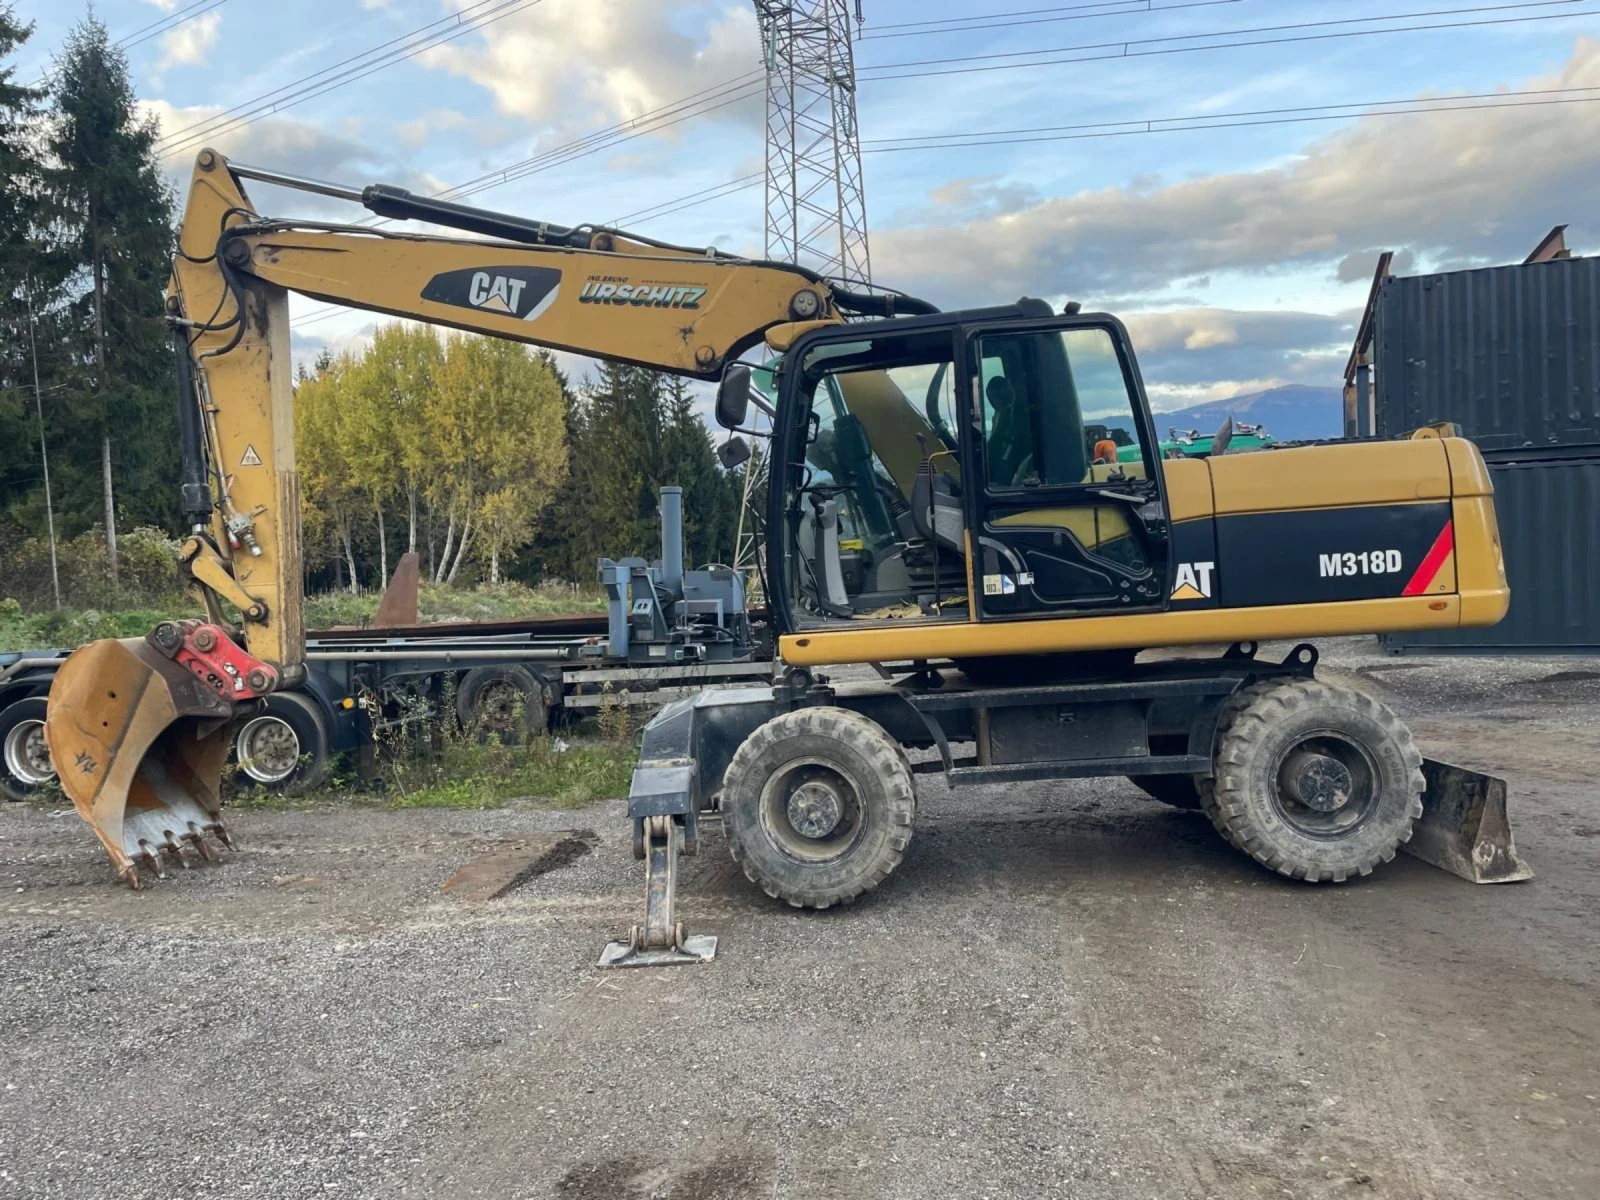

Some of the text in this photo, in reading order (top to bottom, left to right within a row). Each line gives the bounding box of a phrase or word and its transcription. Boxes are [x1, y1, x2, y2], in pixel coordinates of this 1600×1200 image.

[469, 271, 527, 313] CAT
[578, 282, 708, 309] URSCHITZ
[1319, 549, 1402, 577] M318D
[985, 583, 997, 593] 103
[1170, 561, 1215, 600] AT
